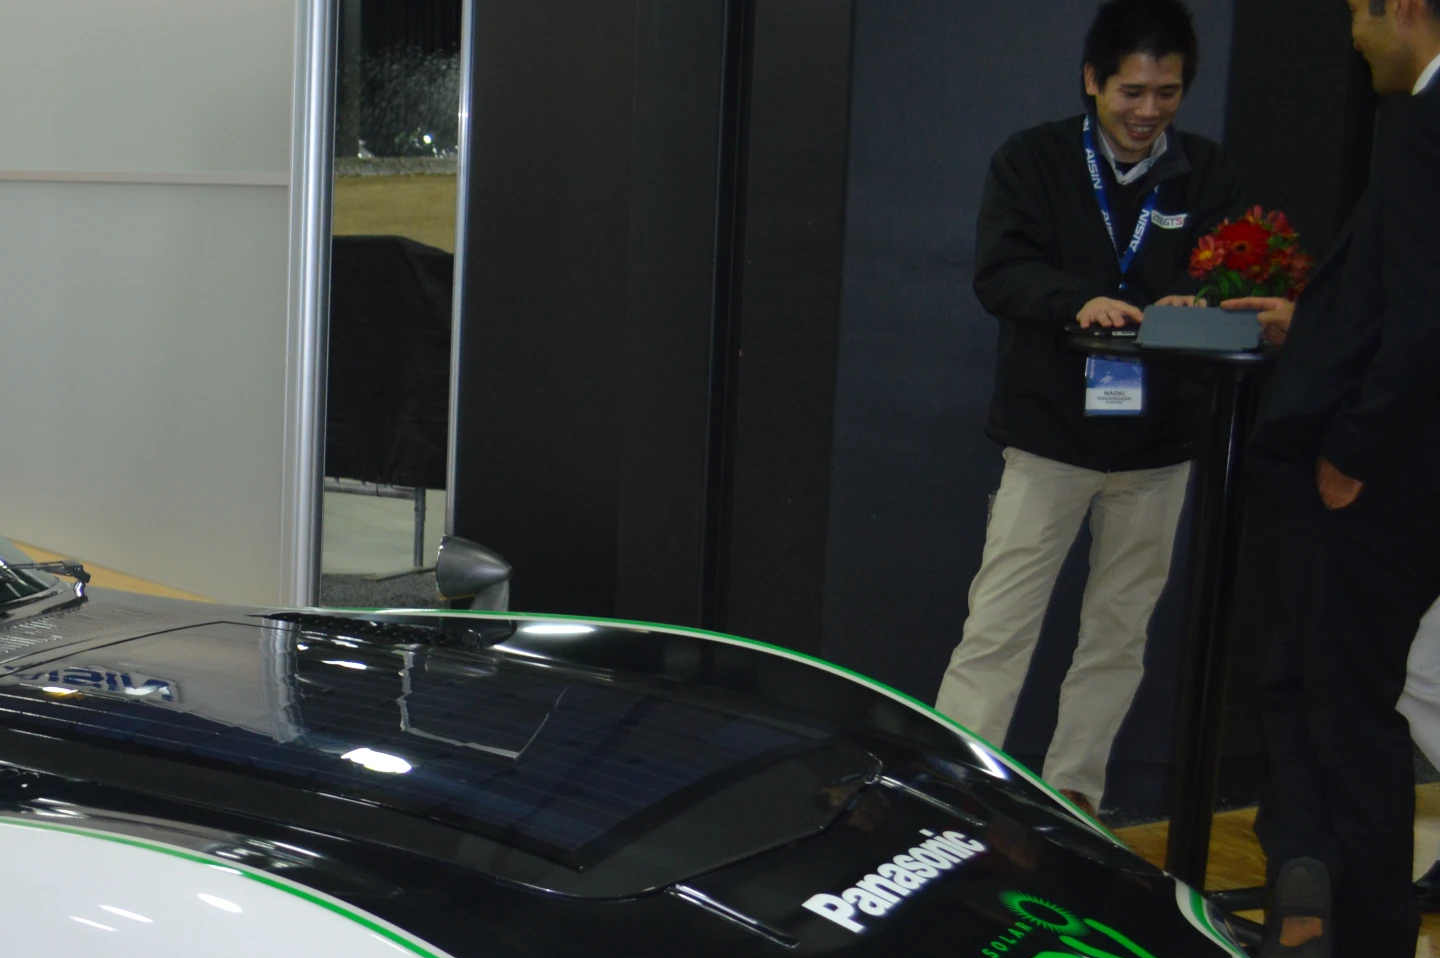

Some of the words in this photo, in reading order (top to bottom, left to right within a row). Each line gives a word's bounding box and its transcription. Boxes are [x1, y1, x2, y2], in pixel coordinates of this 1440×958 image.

[1085, 148, 1102, 189] AISIN
[1129, 208, 1150, 252] AISIN
[801, 828, 988, 934] Panasonic
[981, 920, 1035, 958] SOLAR
